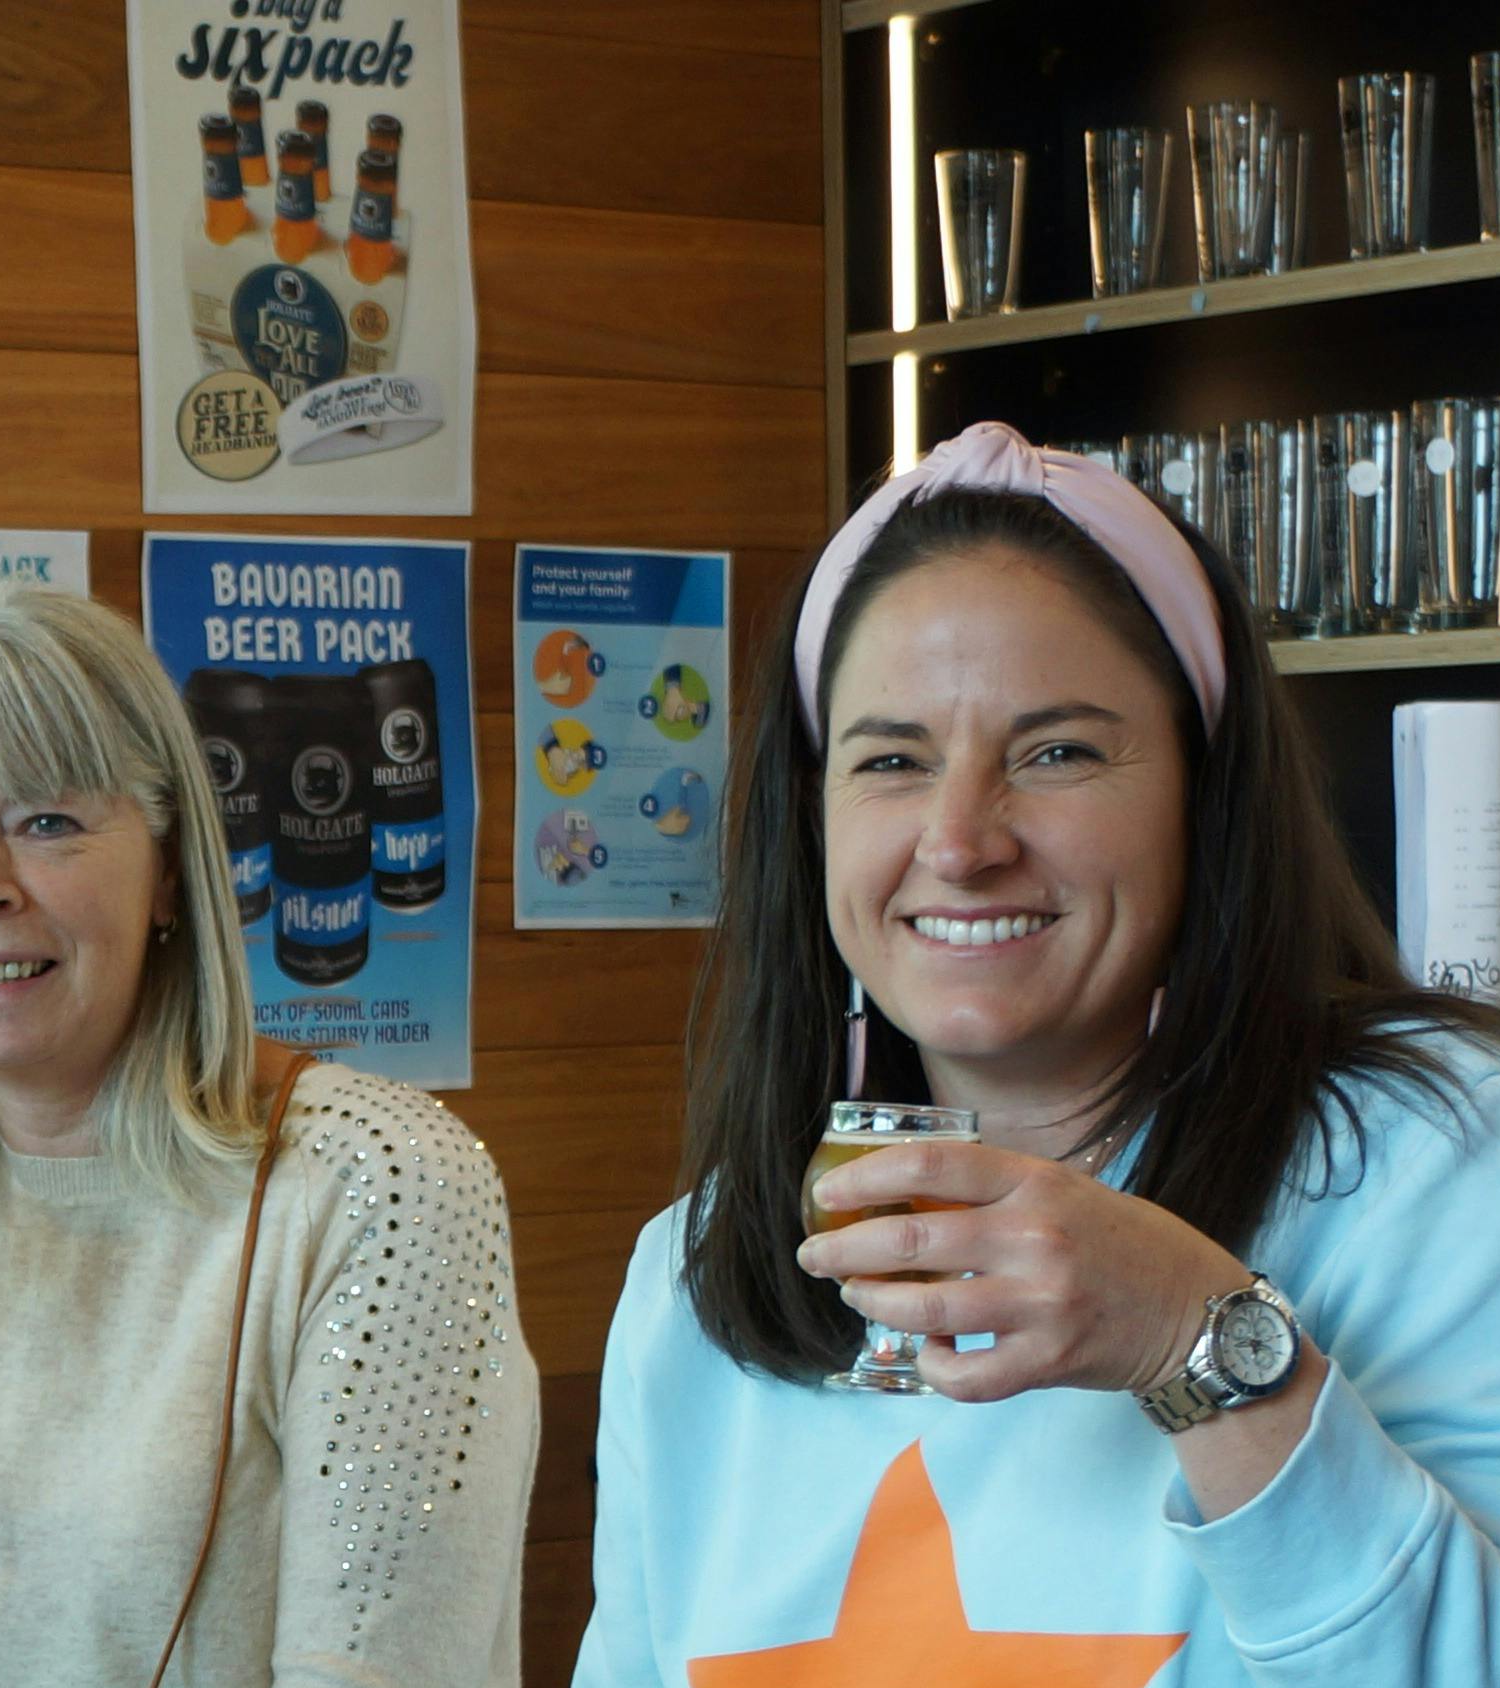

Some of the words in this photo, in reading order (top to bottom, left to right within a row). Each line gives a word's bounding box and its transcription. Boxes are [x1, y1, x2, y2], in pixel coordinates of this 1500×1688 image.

[257, 308, 321, 354] LOVE
[194, 390, 247, 414] GET
[252, 389, 263, 408] A
[194, 411, 269, 441] FREE
[211, 562, 404, 611] BAVARIAN
[532, 565, 578, 582] Protect
[581, 567, 633, 583] yourself
[532, 582, 556, 595] and
[559, 584, 586, 597] your
[589, 584, 630, 600] family
[204, 617, 304, 662] BEER
[314, 619, 413, 663] PACK
[373, 762, 439, 786] HOLGATE
[279, 813, 366, 842] HOLGATE
[288, 1002, 310, 1022] OF
[306, 1025, 370, 1045] STUBBY
[374, 1023, 430, 1043] HOLDER
